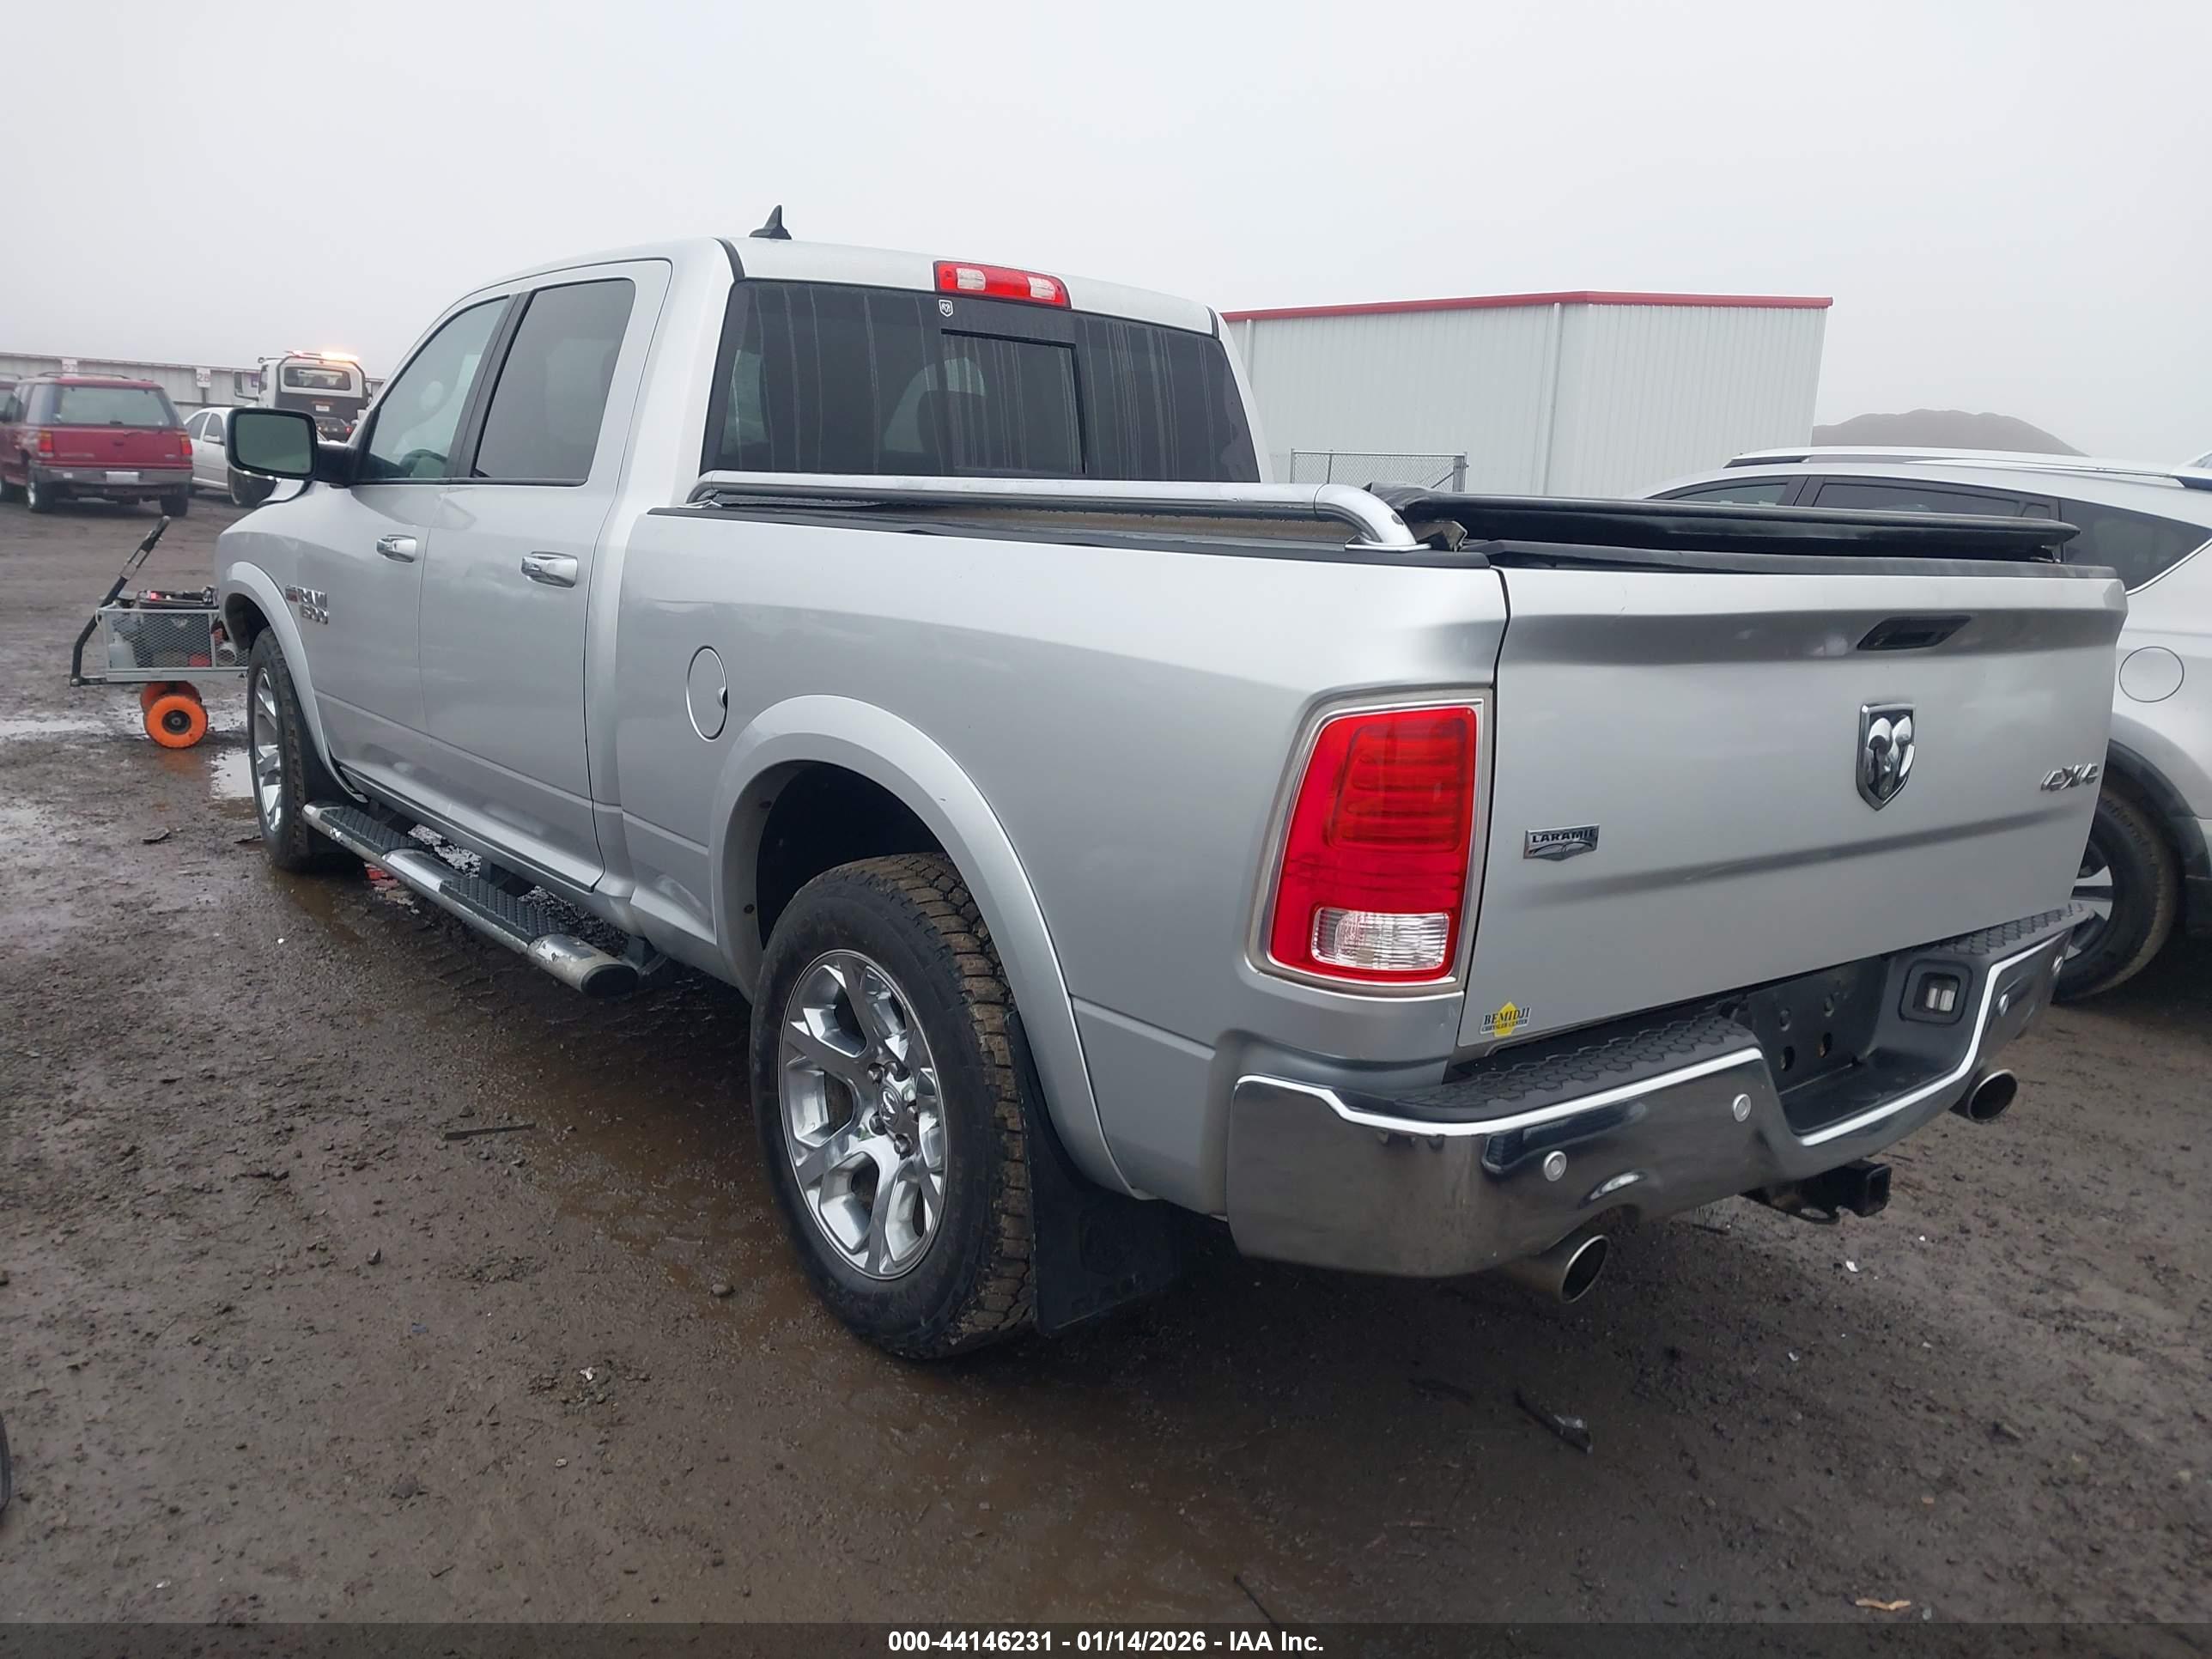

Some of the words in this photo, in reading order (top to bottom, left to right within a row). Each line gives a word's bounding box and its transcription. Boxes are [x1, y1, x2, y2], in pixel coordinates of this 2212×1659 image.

[198, 373, 211, 383] 28
[1532, 828, 1597, 843] LARAMIE
[1484, 1007, 1529, 1025] BEMIDJI
